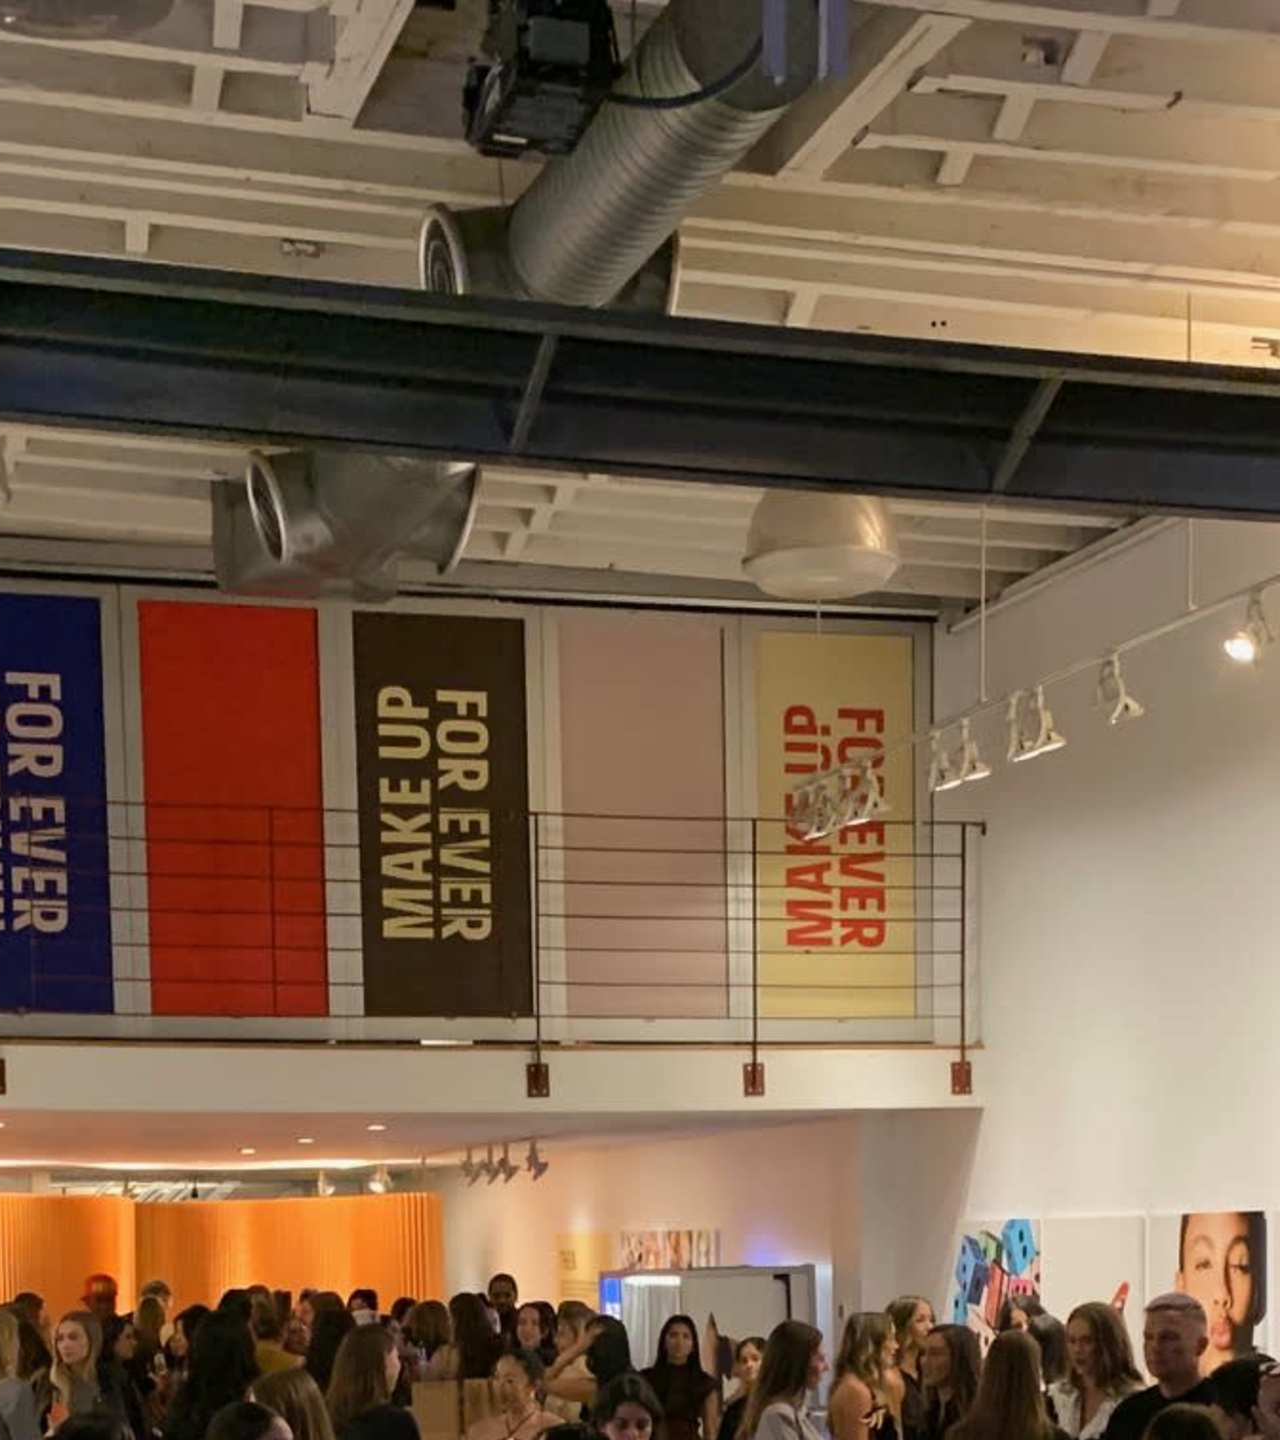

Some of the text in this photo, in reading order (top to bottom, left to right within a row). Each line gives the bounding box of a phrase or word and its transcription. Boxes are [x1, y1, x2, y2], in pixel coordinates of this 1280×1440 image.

[4, 671, 69, 933] FOR EVER
[377, 685, 434, 939] MAKE UP
[435, 689, 492, 941] FOR EVER
[783, 704, 832, 776] UP
[837, 708, 886, 949] FO EVER
